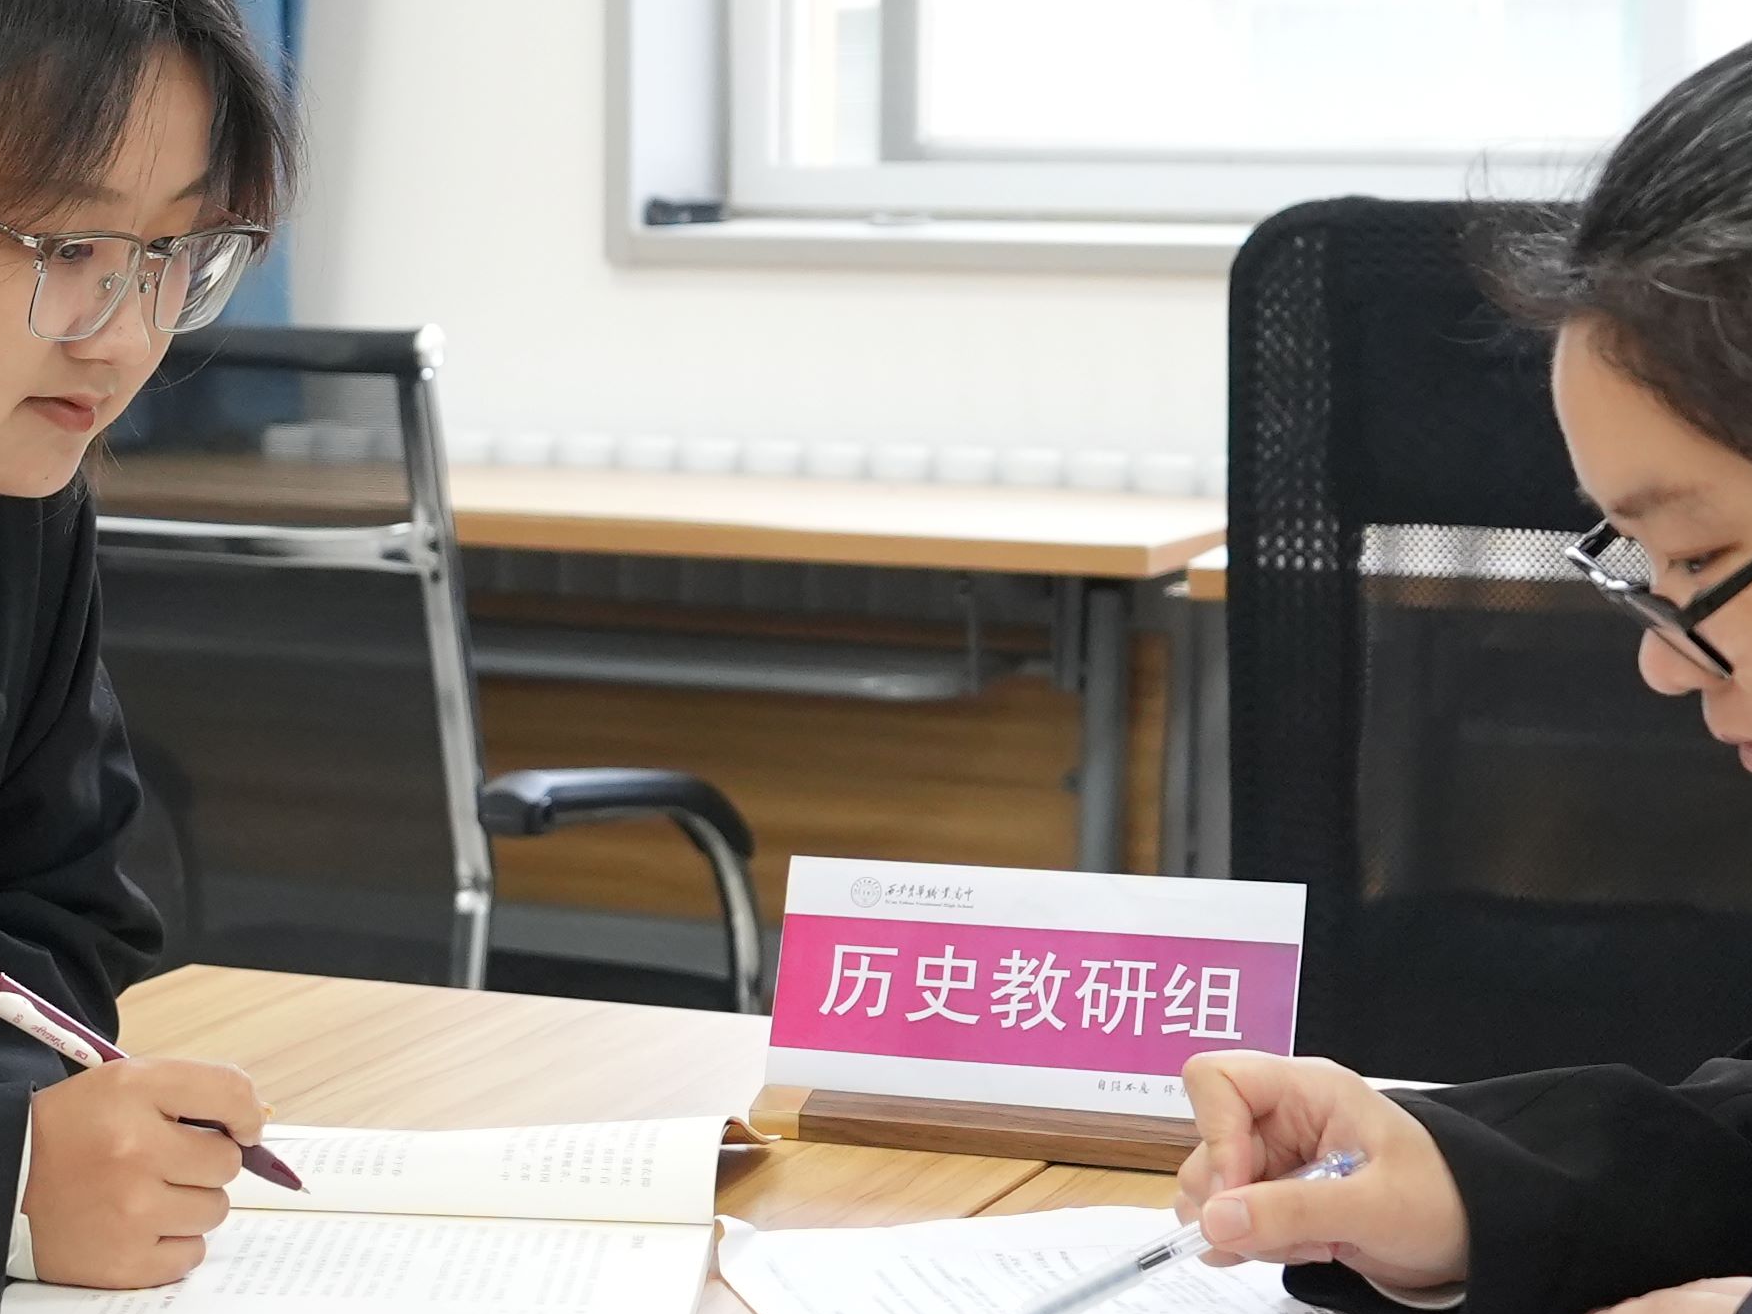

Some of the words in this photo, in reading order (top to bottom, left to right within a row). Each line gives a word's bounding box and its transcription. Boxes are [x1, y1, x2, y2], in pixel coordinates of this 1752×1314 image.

[818, 943, 1243, 1041] 历史教研组
